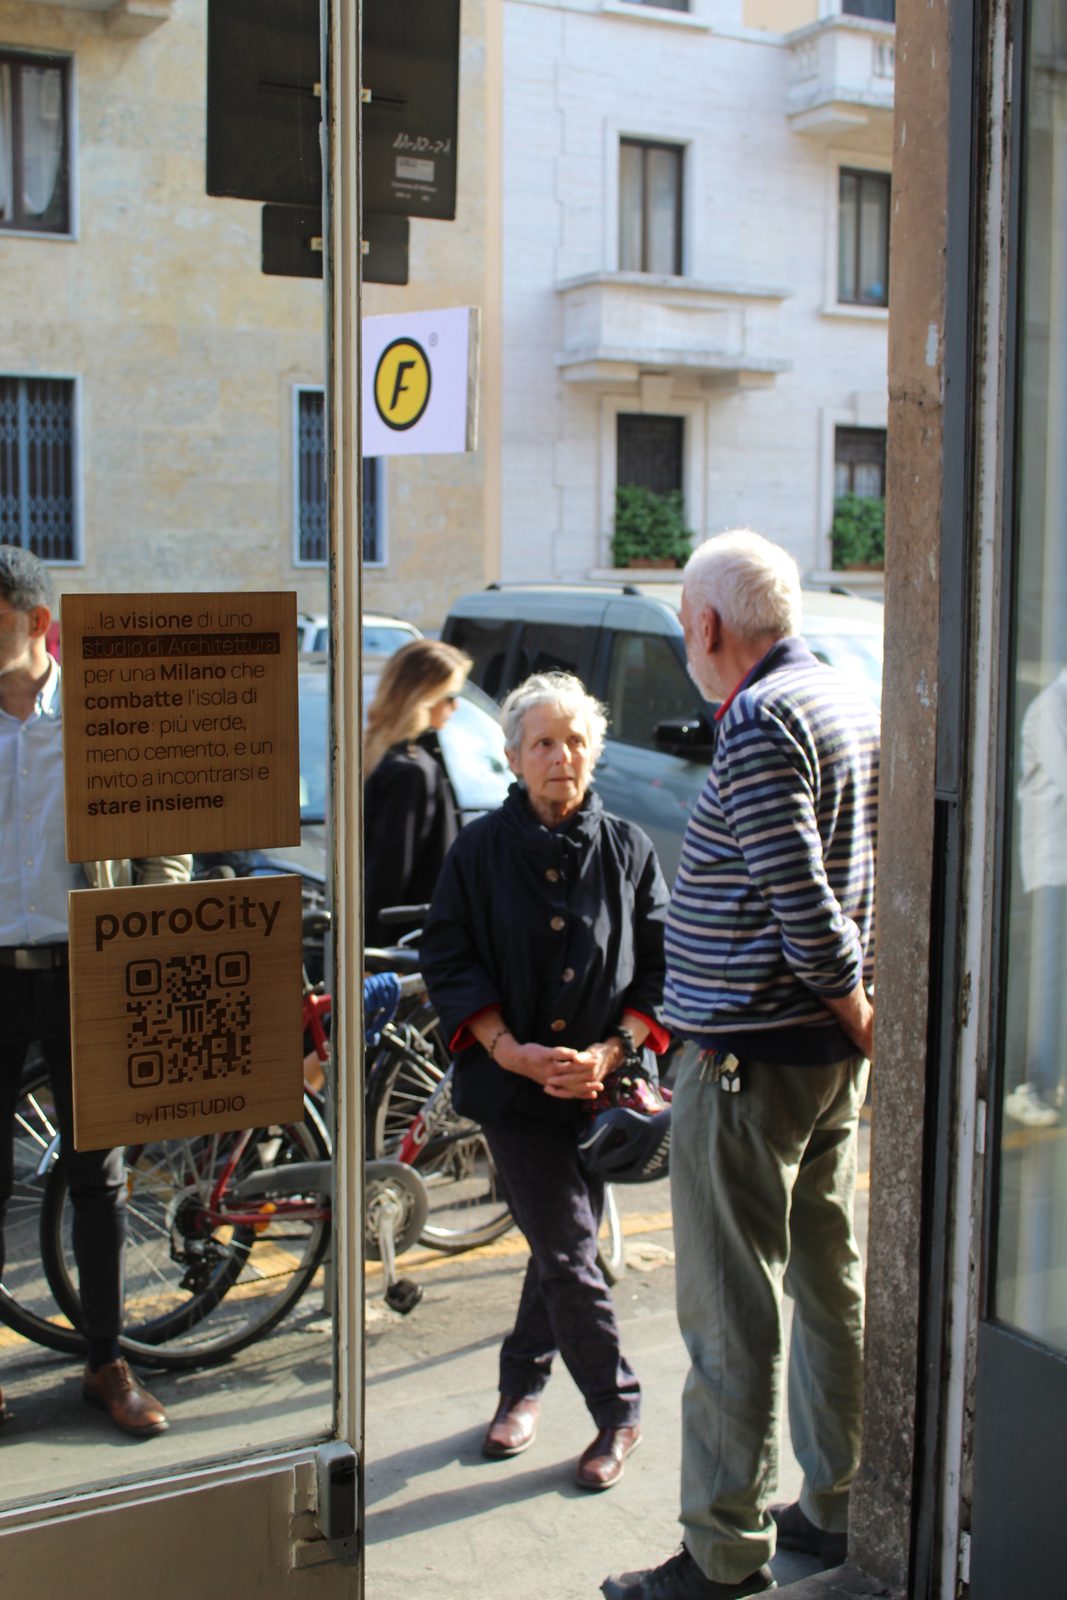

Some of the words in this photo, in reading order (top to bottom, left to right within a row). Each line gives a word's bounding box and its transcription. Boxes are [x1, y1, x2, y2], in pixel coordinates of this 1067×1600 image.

[389, 360, 416, 411] F
[120, 611, 193, 629] visione
[197, 611, 213, 628] di
[216, 612, 252, 627] uno
[83, 637, 143, 658] studio
[147, 636, 164, 655] di
[167, 635, 277, 655] Architettura
[84, 667, 116, 689] per
[120, 666, 155, 683] una
[160, 664, 226, 682] Milano
[231, 662, 265, 679] che
[84, 690, 183, 710] combatte
[241, 688, 257, 705] di
[159, 716, 187, 738] più
[192, 714, 246, 732] verde,
[86, 747, 139, 764] meno
[144, 740, 229, 760] cemento,
[234, 742, 246, 756] e
[251, 740, 273, 755] un
[87, 771, 137, 790] invito
[142, 772, 153, 787] a
[158, 765, 254, 786] incontrarsi
[257, 766, 270, 780] e
[87, 799, 141, 816] stare
[95, 895, 281, 952] poroCity
[135, 1111, 153, 1127] by
[154, 1095, 246, 1122] ITISTUDIO
